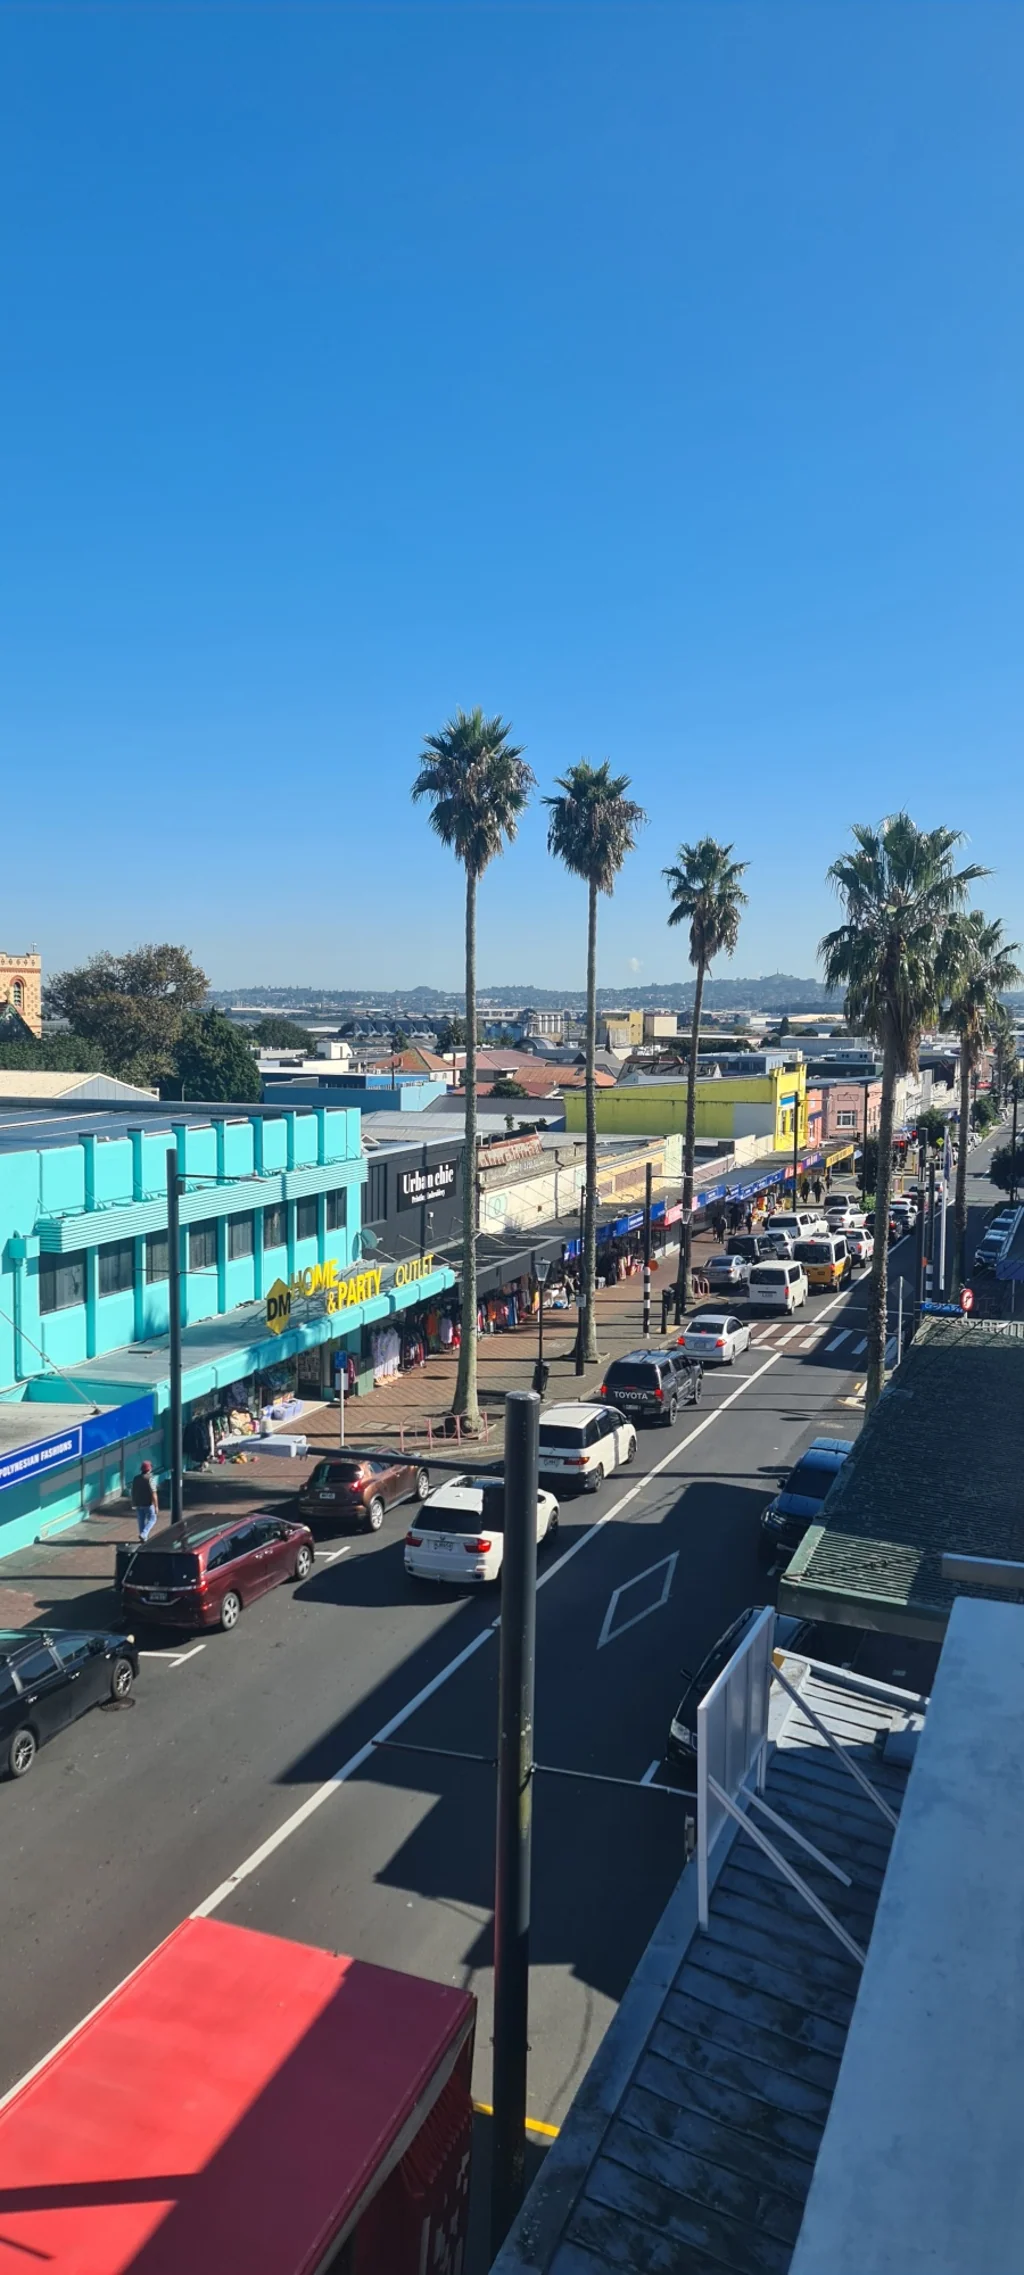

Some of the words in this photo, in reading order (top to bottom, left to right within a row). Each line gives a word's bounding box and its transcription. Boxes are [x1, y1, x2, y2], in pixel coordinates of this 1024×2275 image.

[403, 1171, 433, 1194] Urban
[435, 1164, 454, 1186] chic
[291, 1259, 338, 1297] HOME
[395, 1254, 434, 1286] OUTLET
[267, 1293, 291, 1321] DM
[327, 1291, 337, 1315] &
[338, 1267, 385, 1310] PARTY
[614, 1391, 648, 1400] TOYOTA
[0, 1453, 40, 1478] POLYNESIAN
[41, 1440, 72, 1461] FASHIONS
